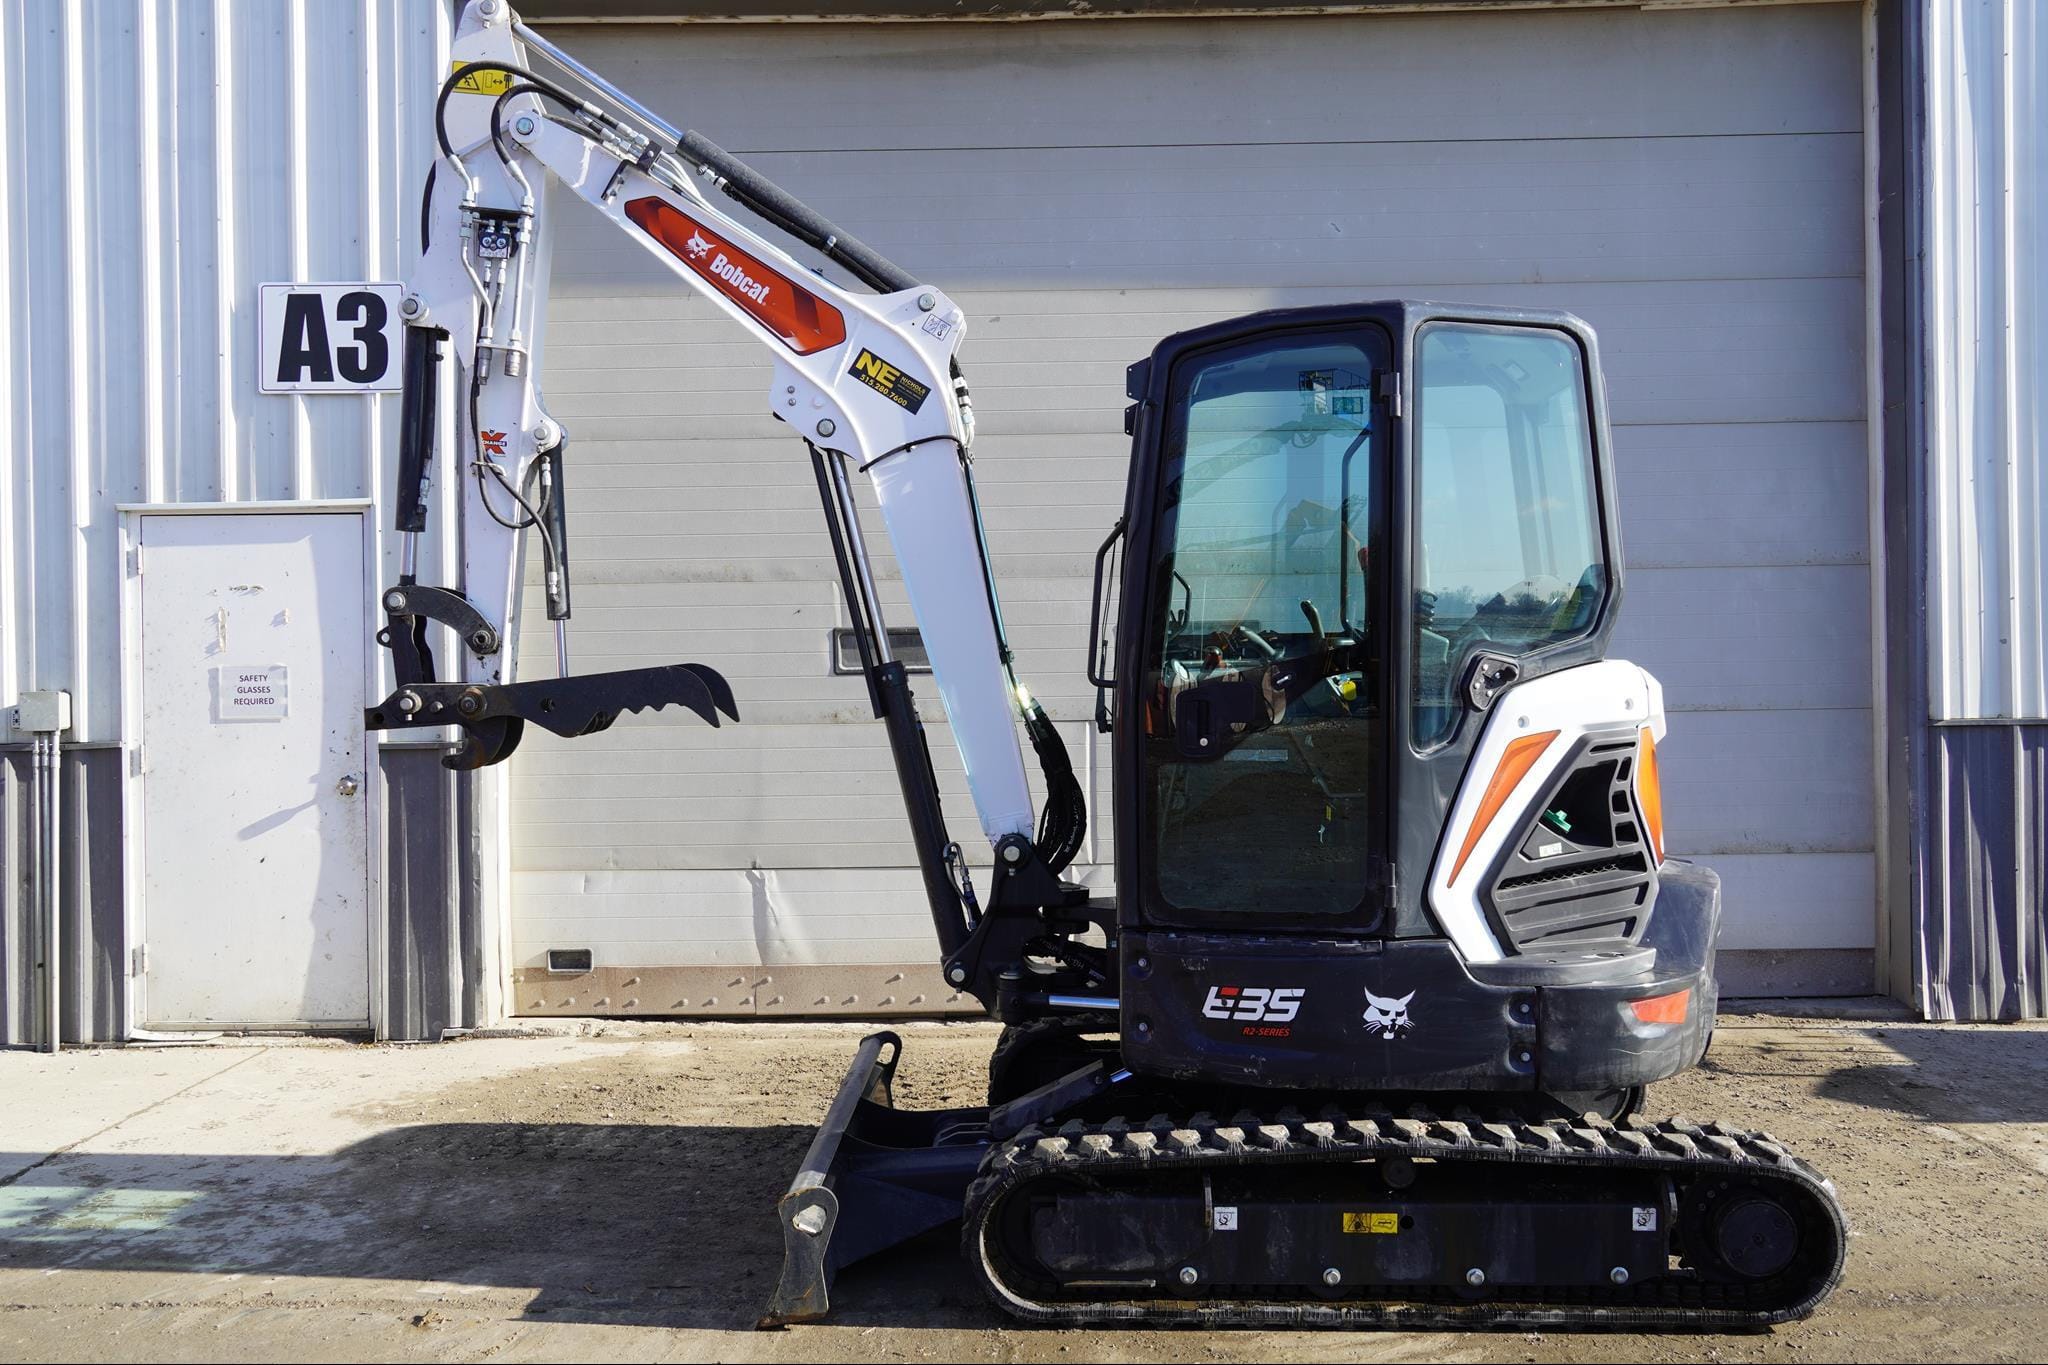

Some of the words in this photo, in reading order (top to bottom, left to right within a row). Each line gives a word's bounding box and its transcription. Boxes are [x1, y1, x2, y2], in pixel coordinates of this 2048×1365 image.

[709, 253, 770, 304] Bobcat
[277, 291, 389, 384] A3
[855, 351, 902, 389] NE
[860, 374, 908, 407] 515.280.7600
[237, 686, 271, 694] GLASSES
[239, 674, 268, 682] SAFETY
[233, 697, 275, 705] REQUIRED
[1202, 986, 1306, 1022] E35
[1242, 1026, 1291, 1037] R2-SERIES
